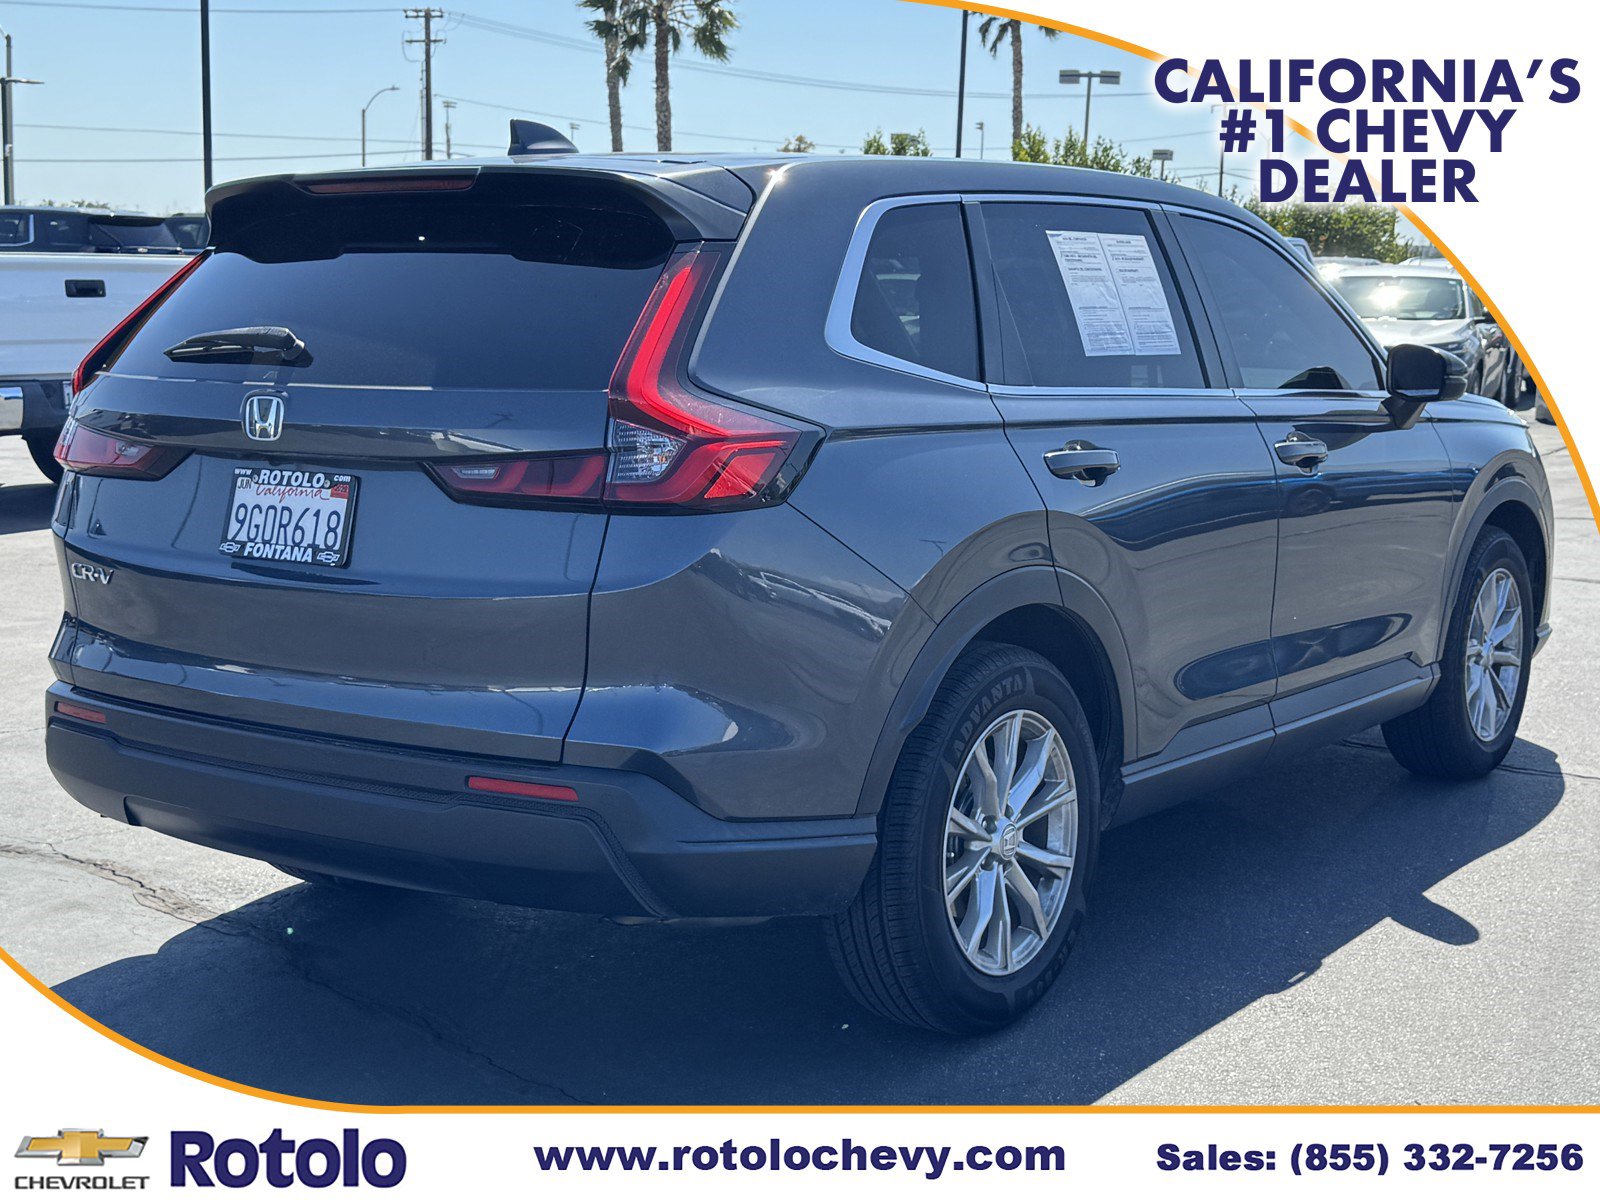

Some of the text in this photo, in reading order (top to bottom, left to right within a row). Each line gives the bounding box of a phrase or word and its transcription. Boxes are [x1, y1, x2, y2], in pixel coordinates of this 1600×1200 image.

[258, 469, 326, 488] ROTOLO
[256, 484, 330, 503] California
[243, 542, 313, 562] FONTANA
[951, 673, 1025, 759] ADVANTA
